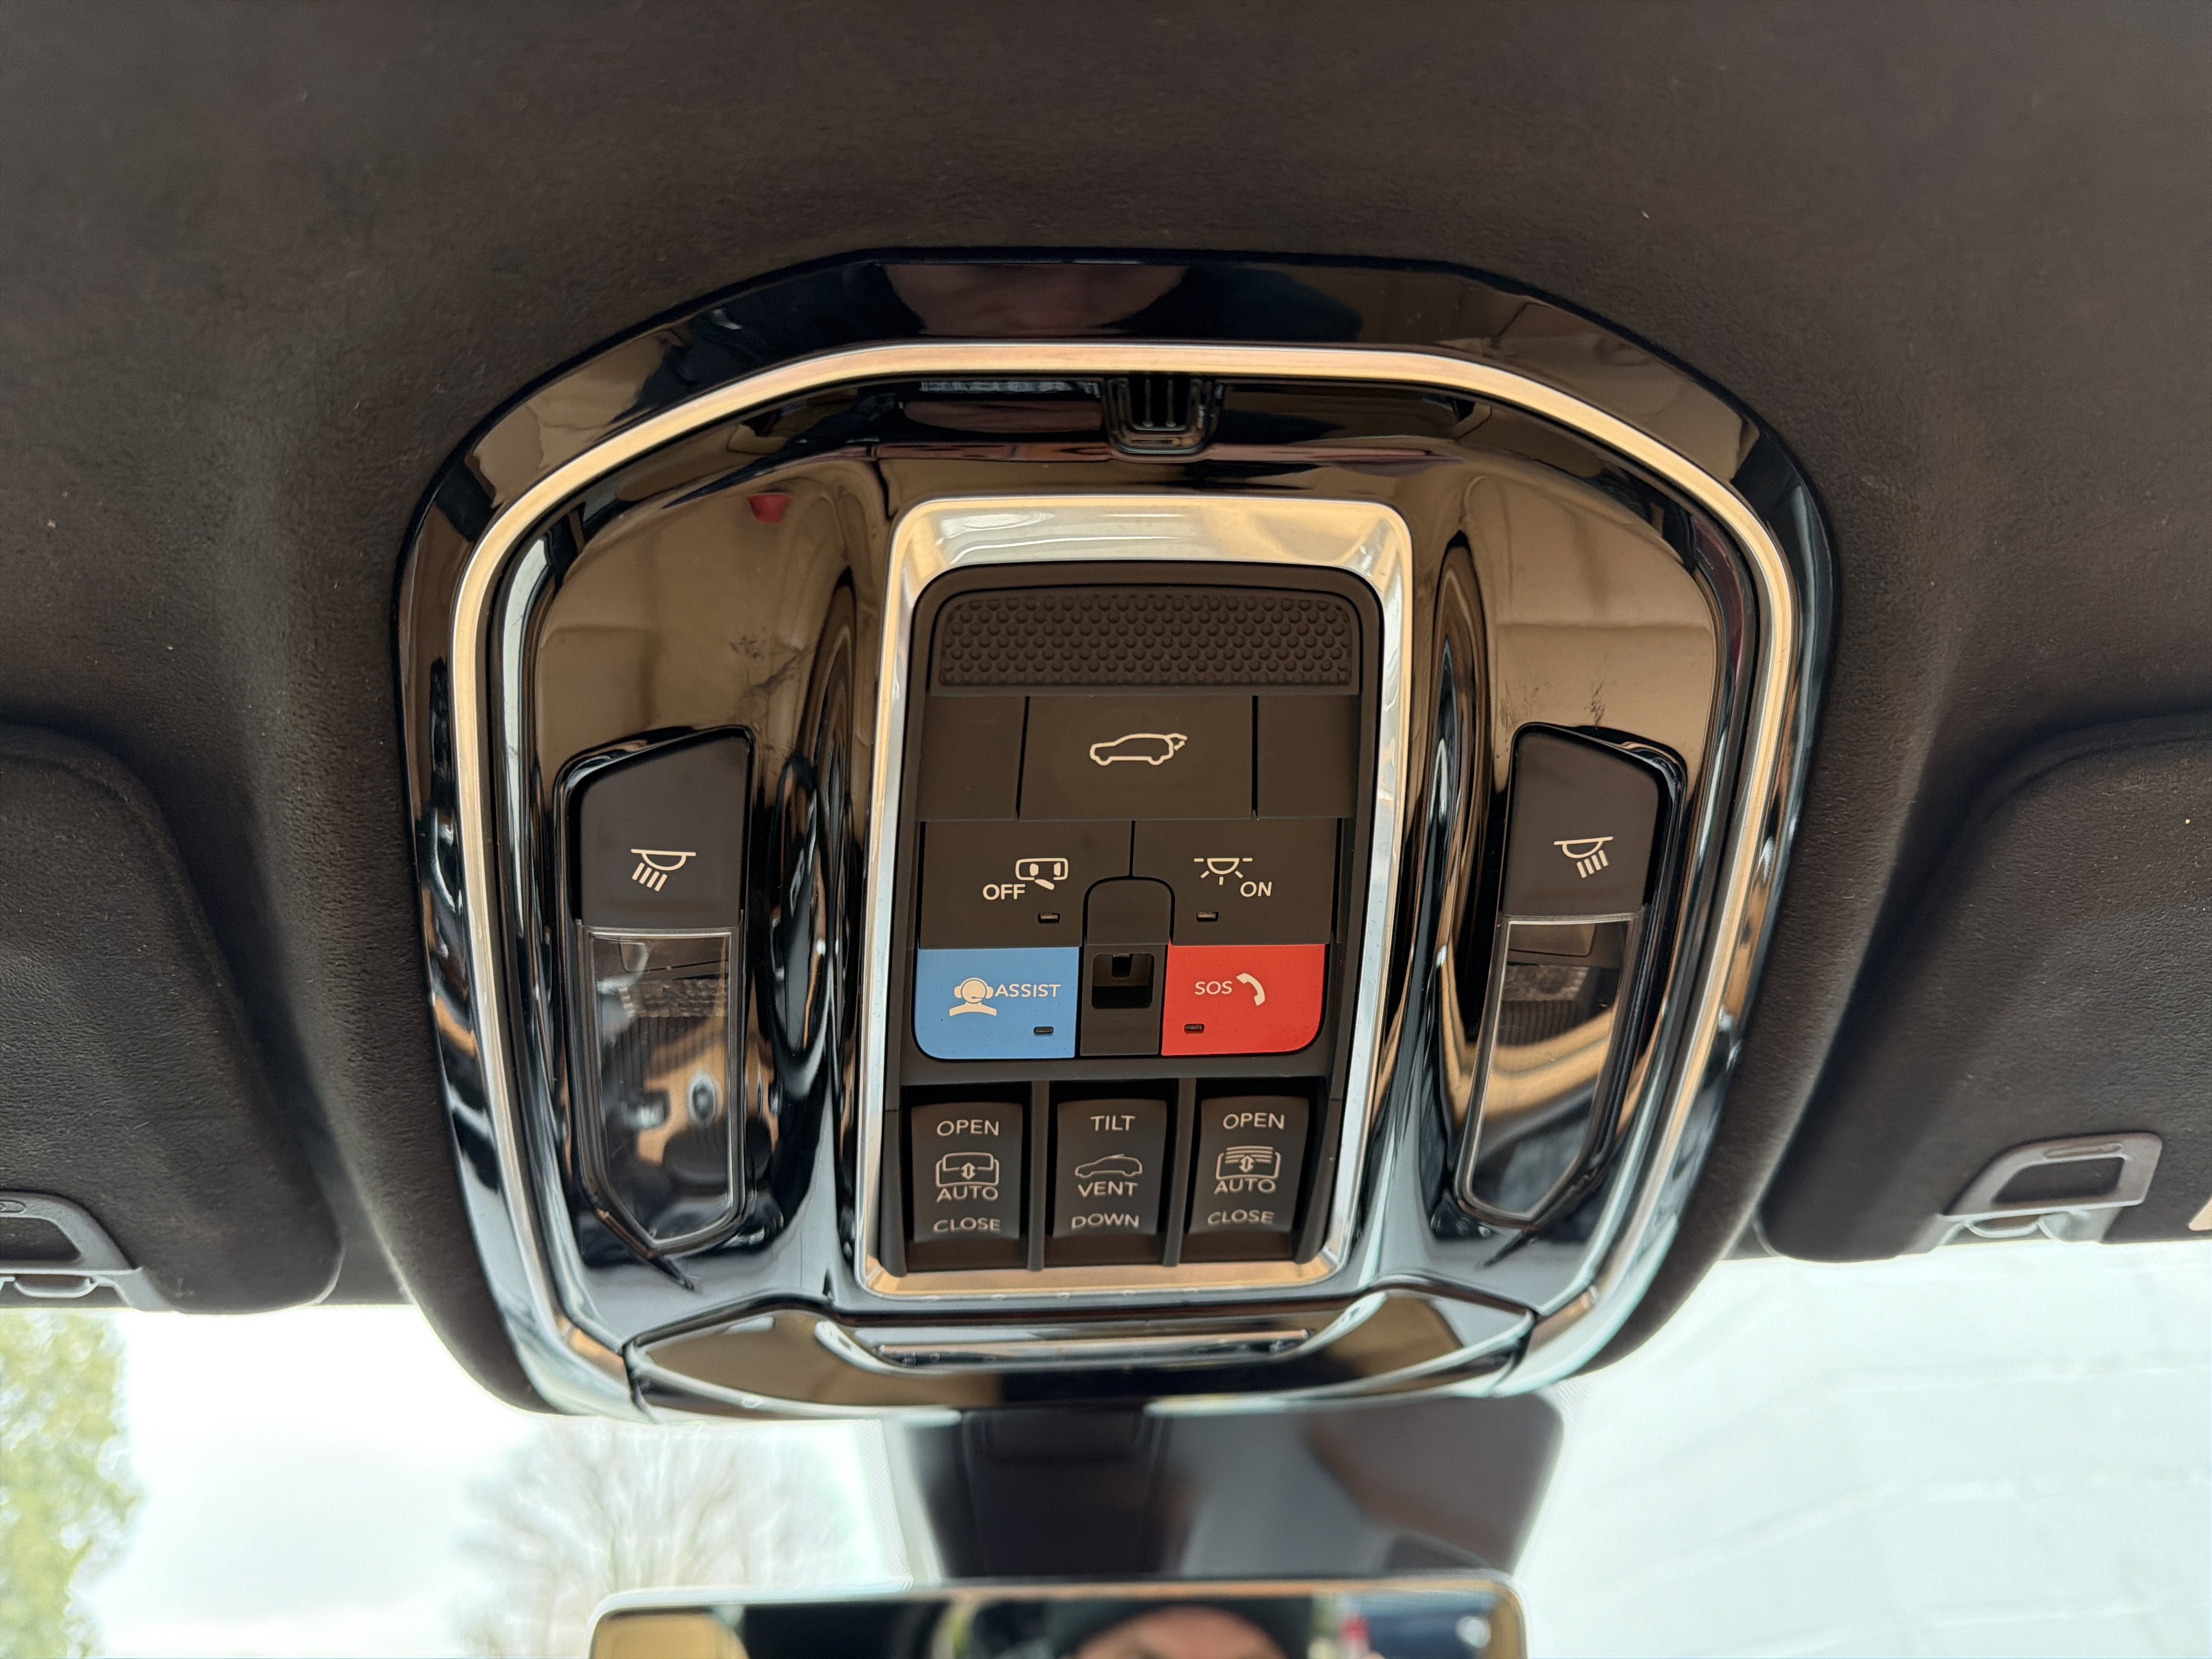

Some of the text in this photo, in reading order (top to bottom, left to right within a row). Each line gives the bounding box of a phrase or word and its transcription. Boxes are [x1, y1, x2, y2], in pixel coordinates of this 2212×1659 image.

[983, 884, 1026, 900] OFF
[1240, 881, 1272, 897] ON
[995, 983, 1060, 997] ASSIST
[1194, 980, 1232, 995] SOS
[936, 1120, 1000, 1137] OPEN
[1090, 1115, 1135, 1131] TILT
[1222, 1113, 1285, 1130] OPEN
[936, 1186, 998, 1202] AUTO
[1077, 1182, 1138, 1198] VENT
[1214, 1179, 1277, 1194] AUTO
[933, 1217, 1001, 1233] CLOSE
[1071, 1214, 1139, 1230] DOWN
[1207, 1209, 1274, 1226] CLOSE
